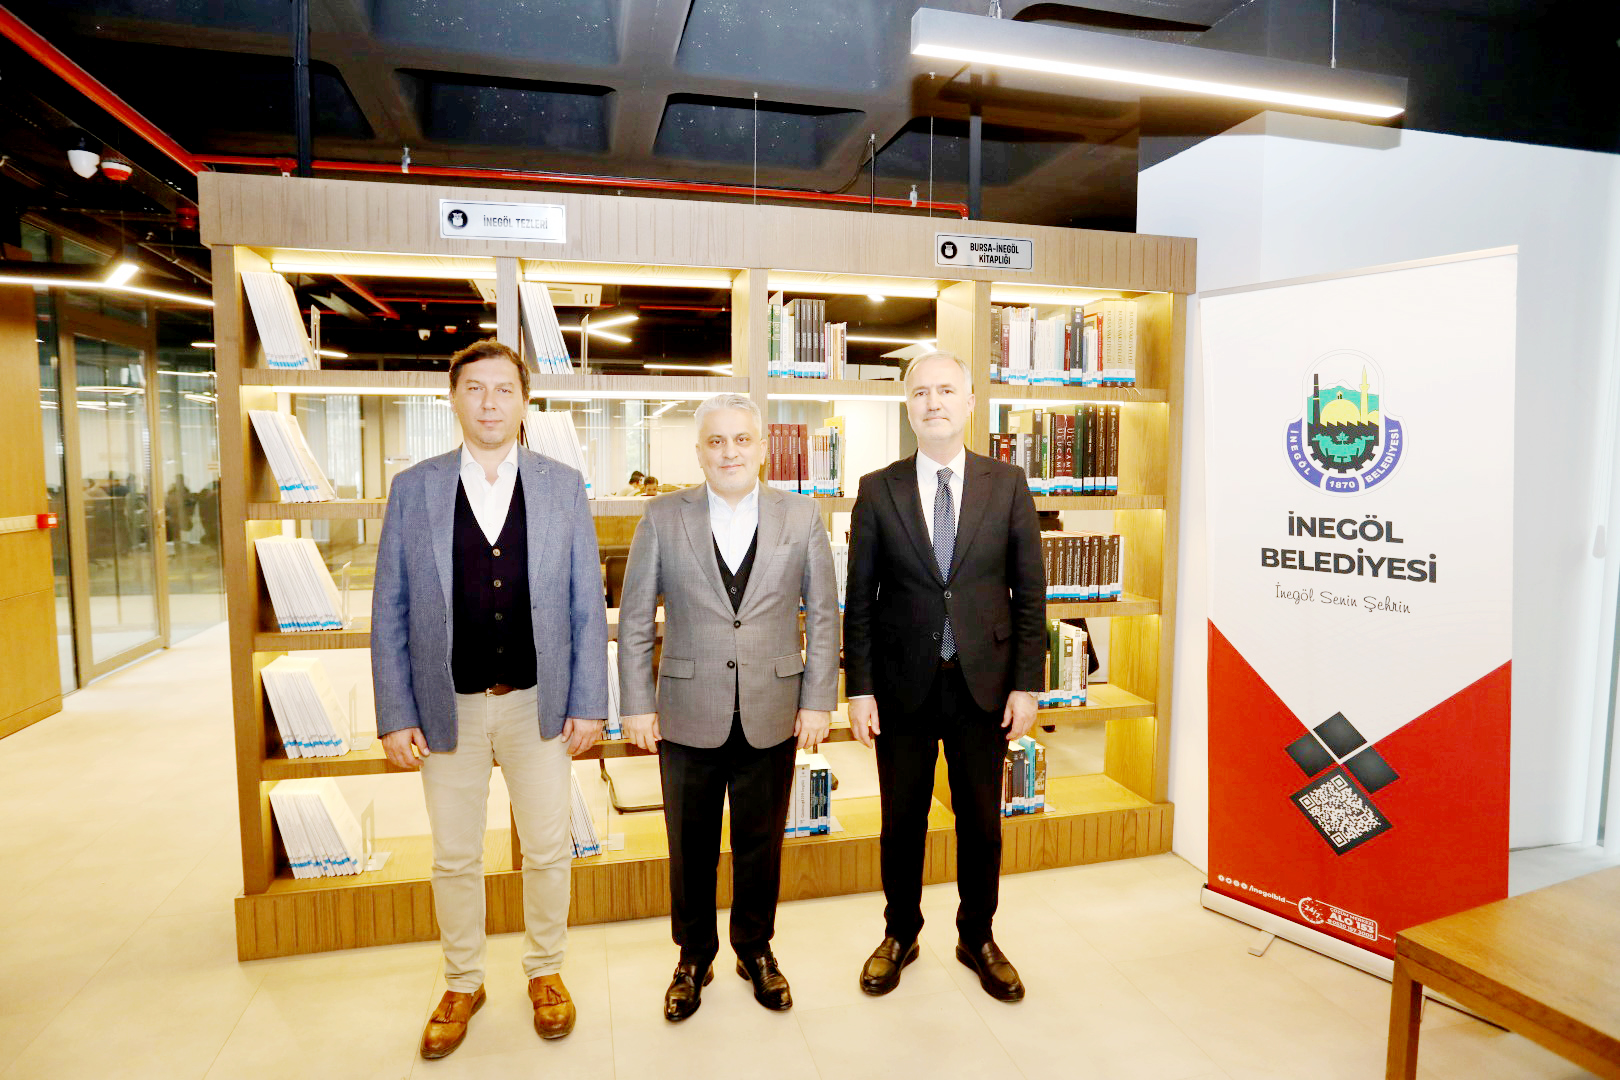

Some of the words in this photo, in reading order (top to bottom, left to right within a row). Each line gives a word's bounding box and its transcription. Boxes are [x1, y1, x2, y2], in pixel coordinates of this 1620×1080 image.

[483, 214, 513, 228] İNEGÖL
[515, 217, 548, 230] TEZLERİ
[970, 242, 1019, 254] BURSA-İNEGÖL
[978, 253, 1011, 265] KİTAPLIĞI
[1289, 430, 1311, 476] İNEGÖL
[1364, 428, 1400, 484] BELEDİYESİ
[1329, 480, 1356, 489] 1870
[1288, 510, 1404, 544] İNEGÖL
[1261, 547, 1437, 583] BELEDİYESİ
[1275, 581, 1315, 605] İnegöl
[1319, 590, 1358, 608] Senin
[1363, 595, 1411, 614] Şehrin
[1304, 904, 1321, 919] 24/7
[1329, 912, 1353, 926] ALO
[1355, 921, 1374, 933] 153
